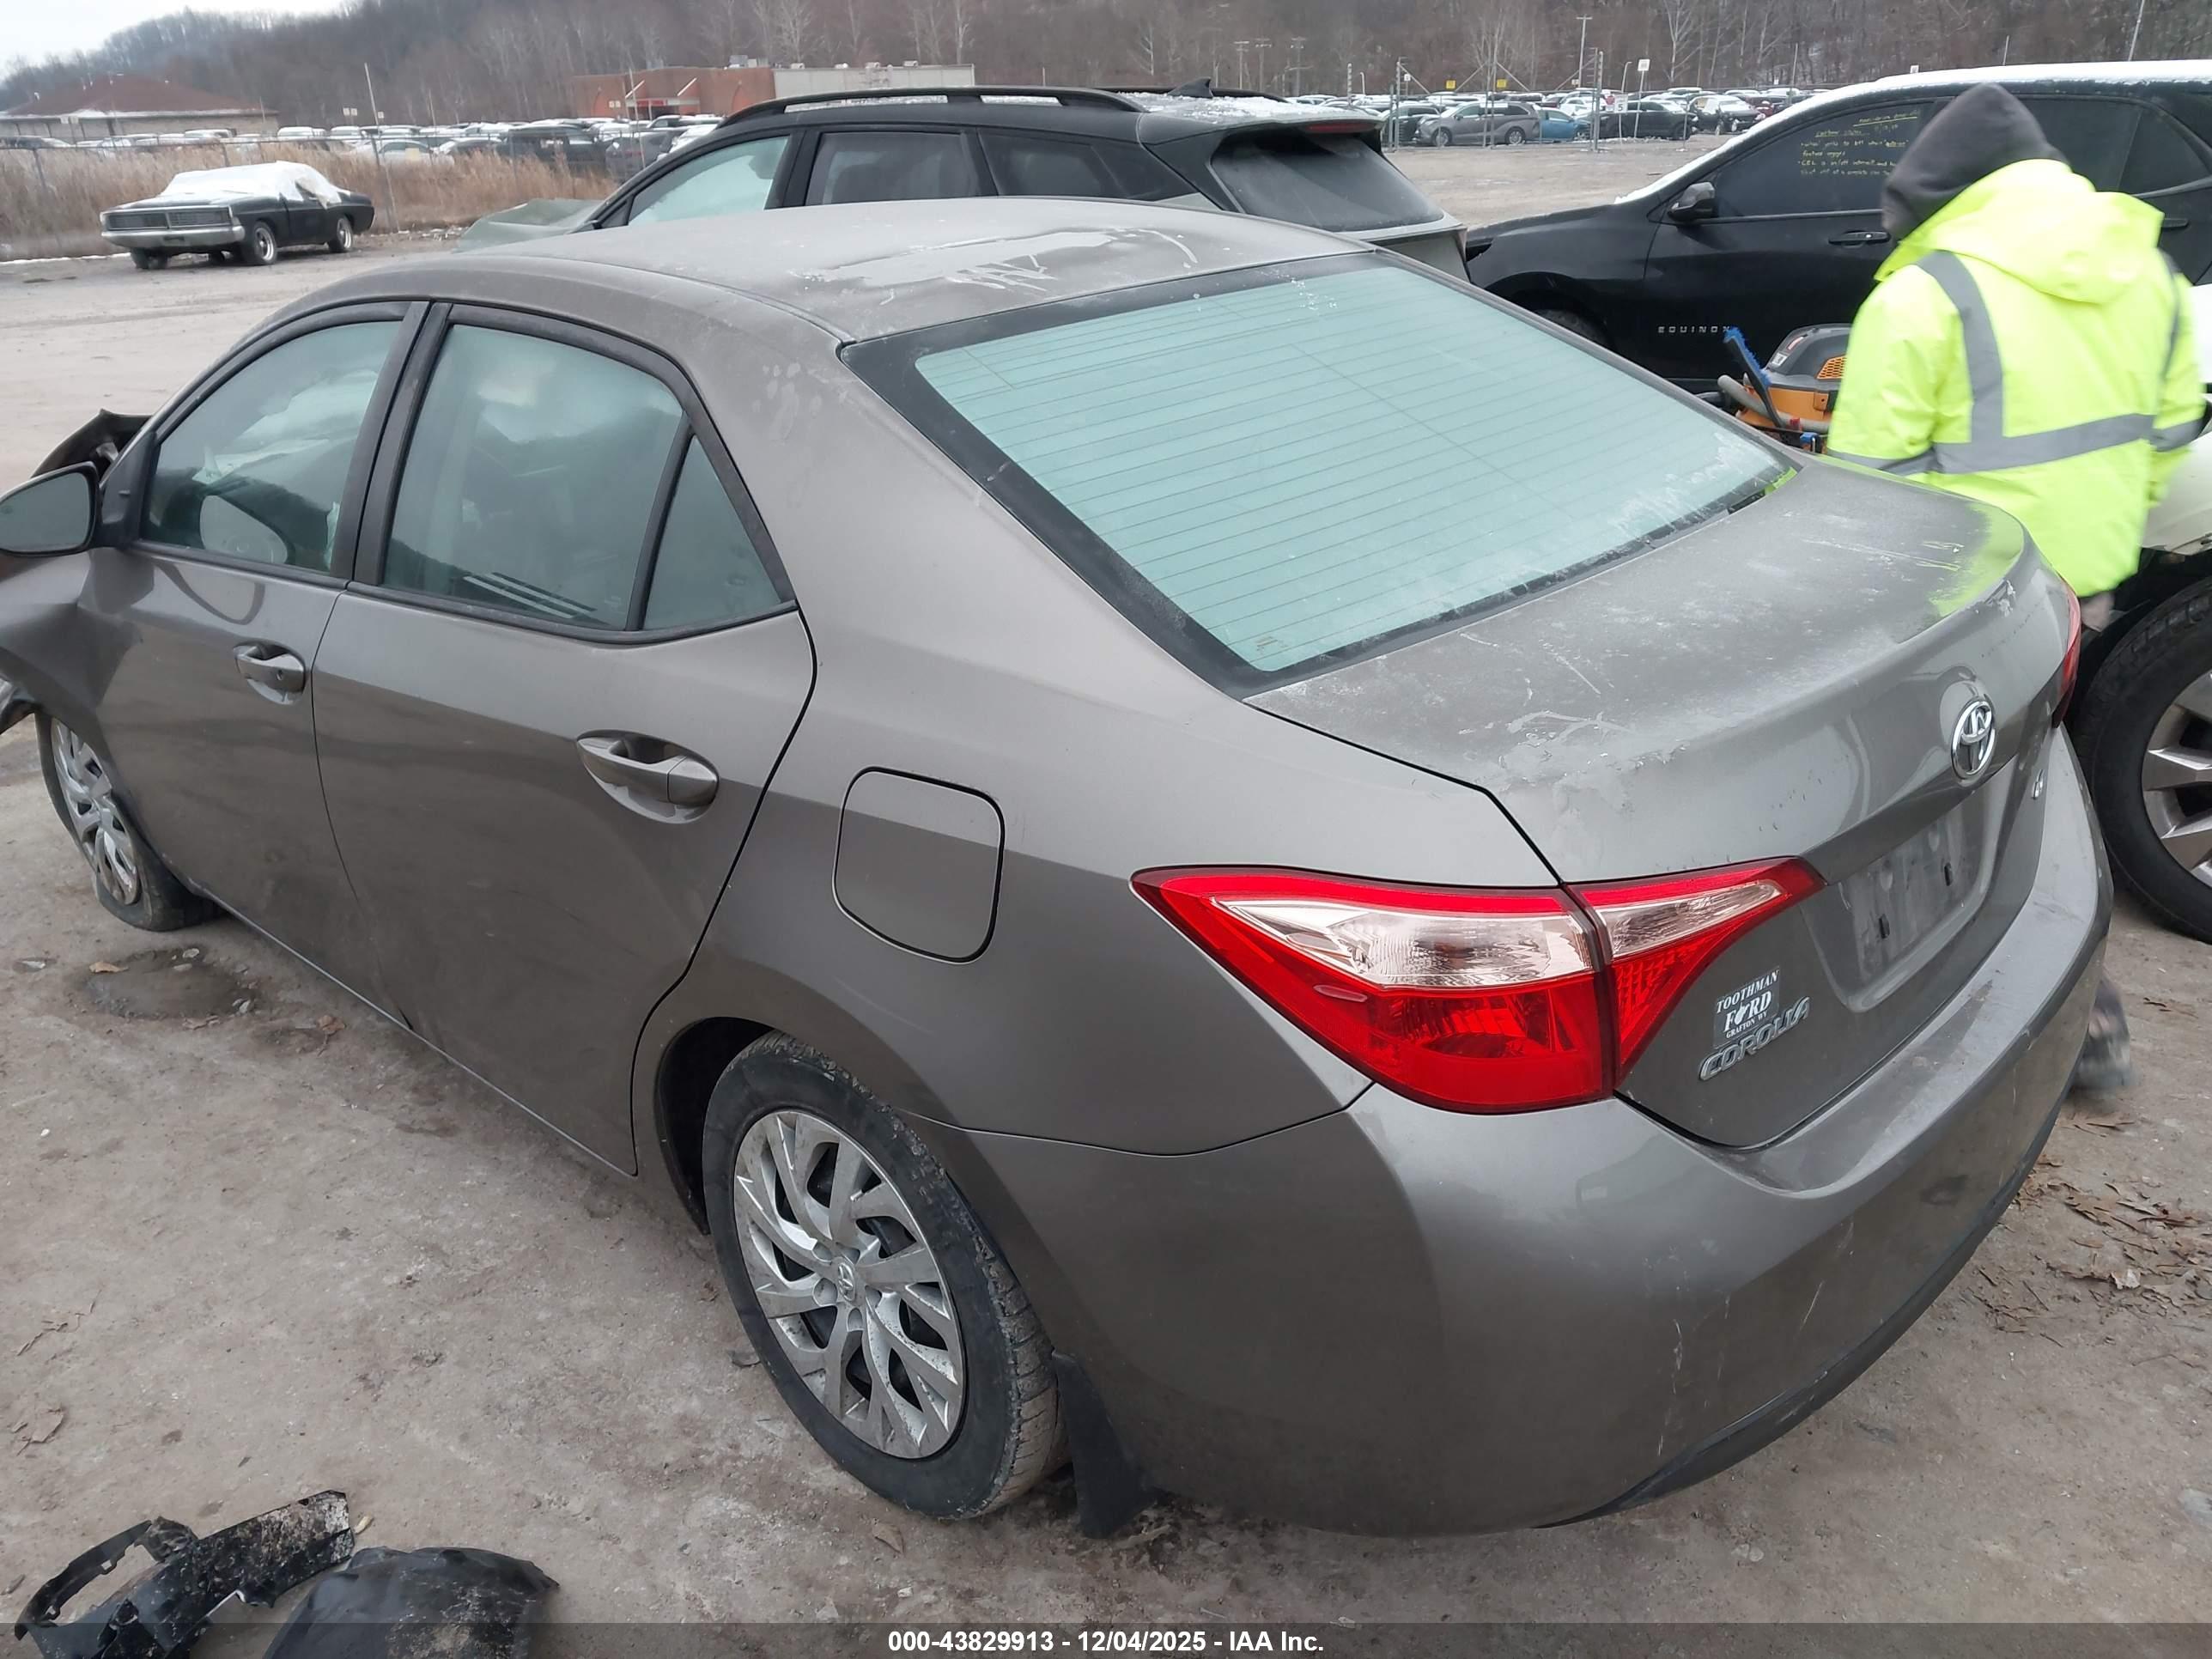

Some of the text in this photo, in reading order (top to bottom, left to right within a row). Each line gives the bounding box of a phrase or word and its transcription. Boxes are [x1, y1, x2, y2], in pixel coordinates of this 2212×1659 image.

[1717, 970, 1780, 1013] TOOTHMAN
[1699, 997, 1809, 1080] COROLLA
[1726, 1018, 1755, 1038] GRAFTON
